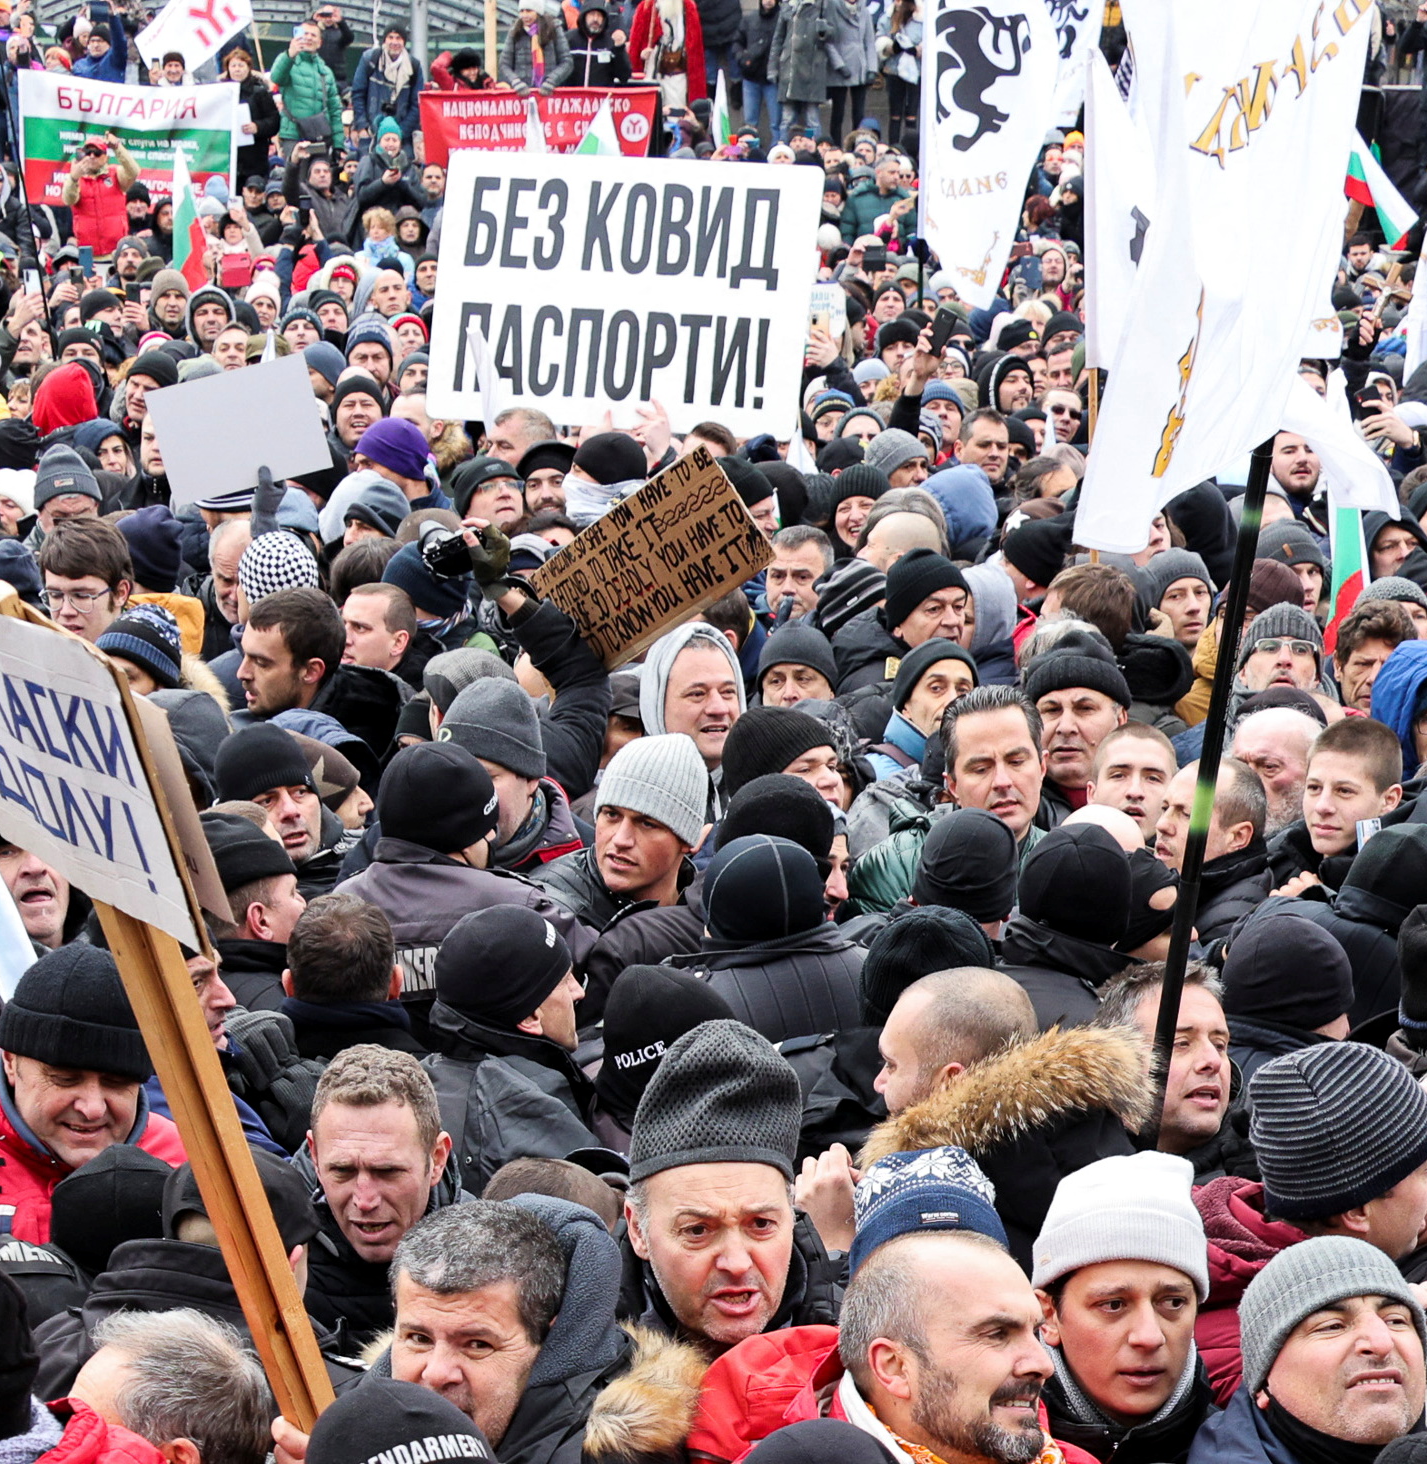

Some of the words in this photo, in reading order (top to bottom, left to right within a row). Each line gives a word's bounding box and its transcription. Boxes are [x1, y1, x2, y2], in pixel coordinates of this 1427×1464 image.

[58, 87, 198, 119] БЪЛГАРИЯ
[443, 98, 535, 119] НАЦИОНАЛНОТ
[463, 176, 569, 271] БЕЗ
[581, 180, 781, 291] КОВИД
[452, 301, 771, 410] ПАСПОРТИ!
[607, 508, 634, 532] YOU
[636, 476, 671, 513] HAVE
[672, 463, 691, 487] TO
[693, 447, 713, 471] BE
[599, 531, 641, 569] TAKE
[604, 560, 658, 611] DEADLY
[658, 538, 687, 572] YOU
[689, 514, 725, 552] HAVE
[721, 499, 745, 529] TO
[611, 595, 655, 642] KNOW
[678, 555, 725, 599] HAVE
[614, 1040, 667, 1070] POLICE
